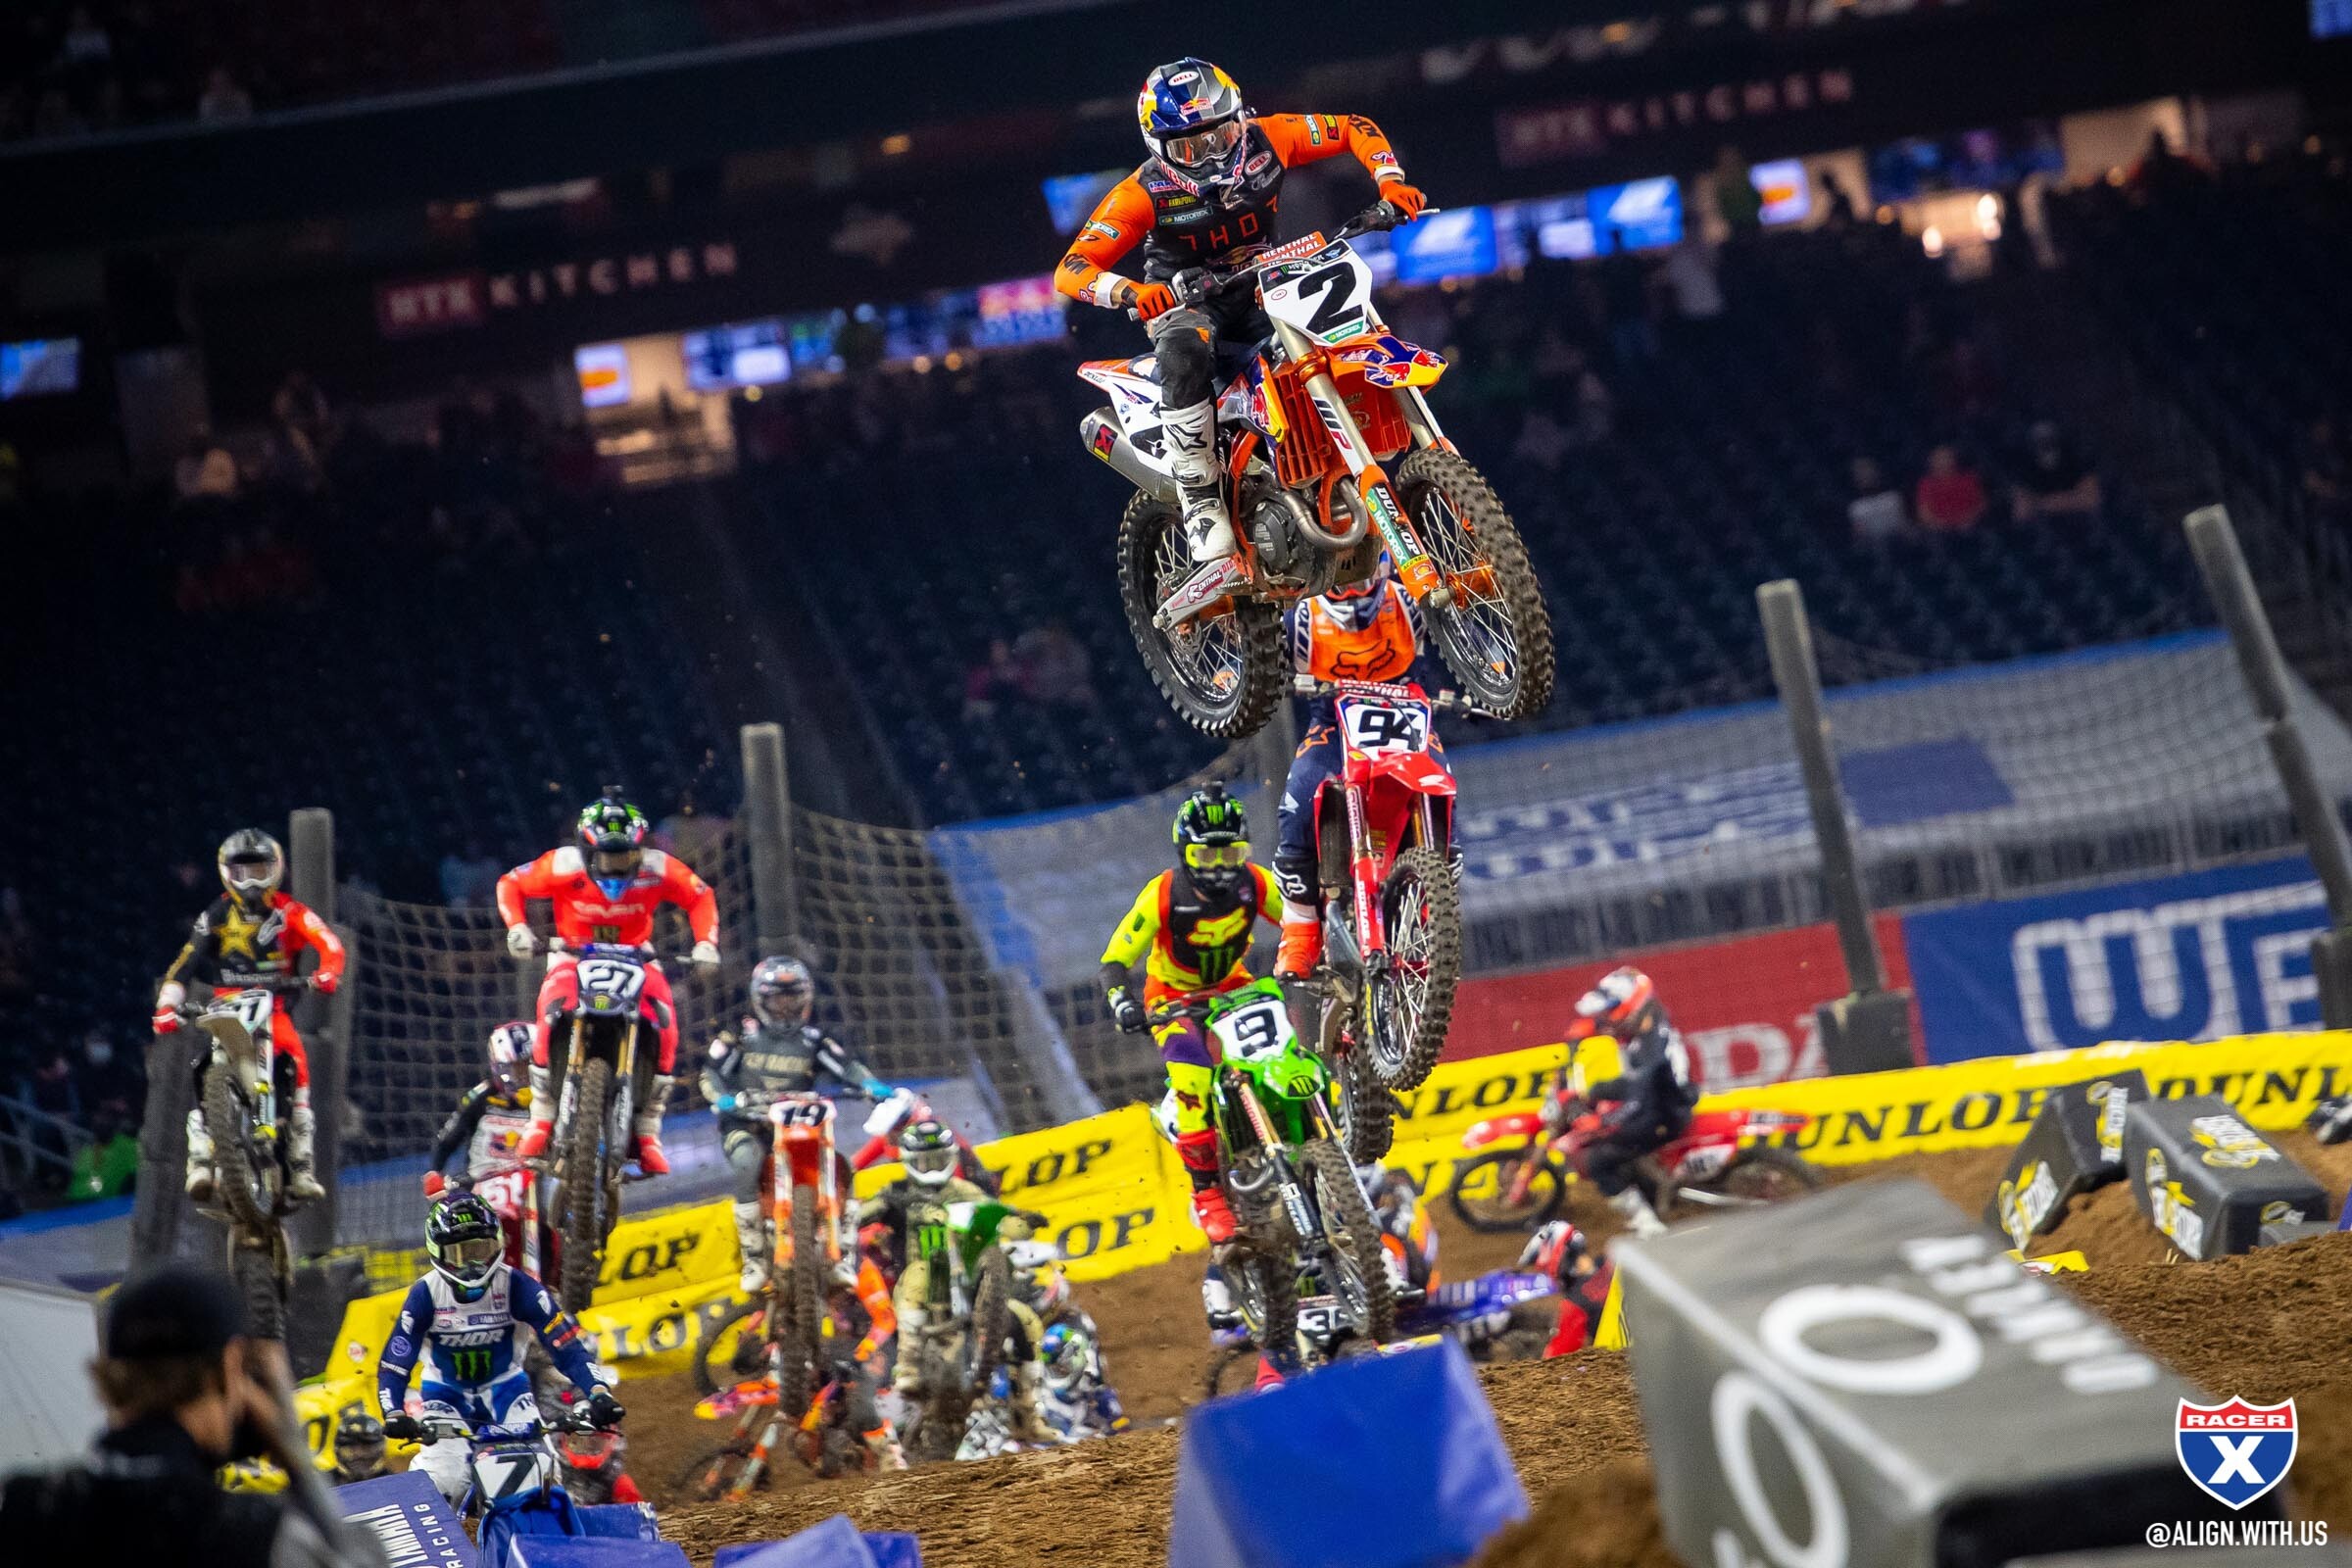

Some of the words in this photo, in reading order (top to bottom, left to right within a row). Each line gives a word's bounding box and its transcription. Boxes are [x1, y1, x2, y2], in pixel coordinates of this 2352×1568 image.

[1173, 209, 1209, 223] MOTOREX
[1262, 234, 1317, 259] RENTHAL
[1270, 242, 1322, 263] ENTHAL
[1298, 261, 1364, 335] 2
[1374, 510, 1407, 565] MOTOREX
[1375, 487, 1422, 556] DUNOP
[1187, 568, 1223, 604] RENTHAL
[1357, 710, 1420, 752] 94
[1235, 1006, 1278, 1057] 9
[1769, 1086, 2052, 1151] UNLOP
[438, 1328, 506, 1348] THOR
[496, 1453, 536, 1500] 7
[414, 1503, 465, 1568] RACING
